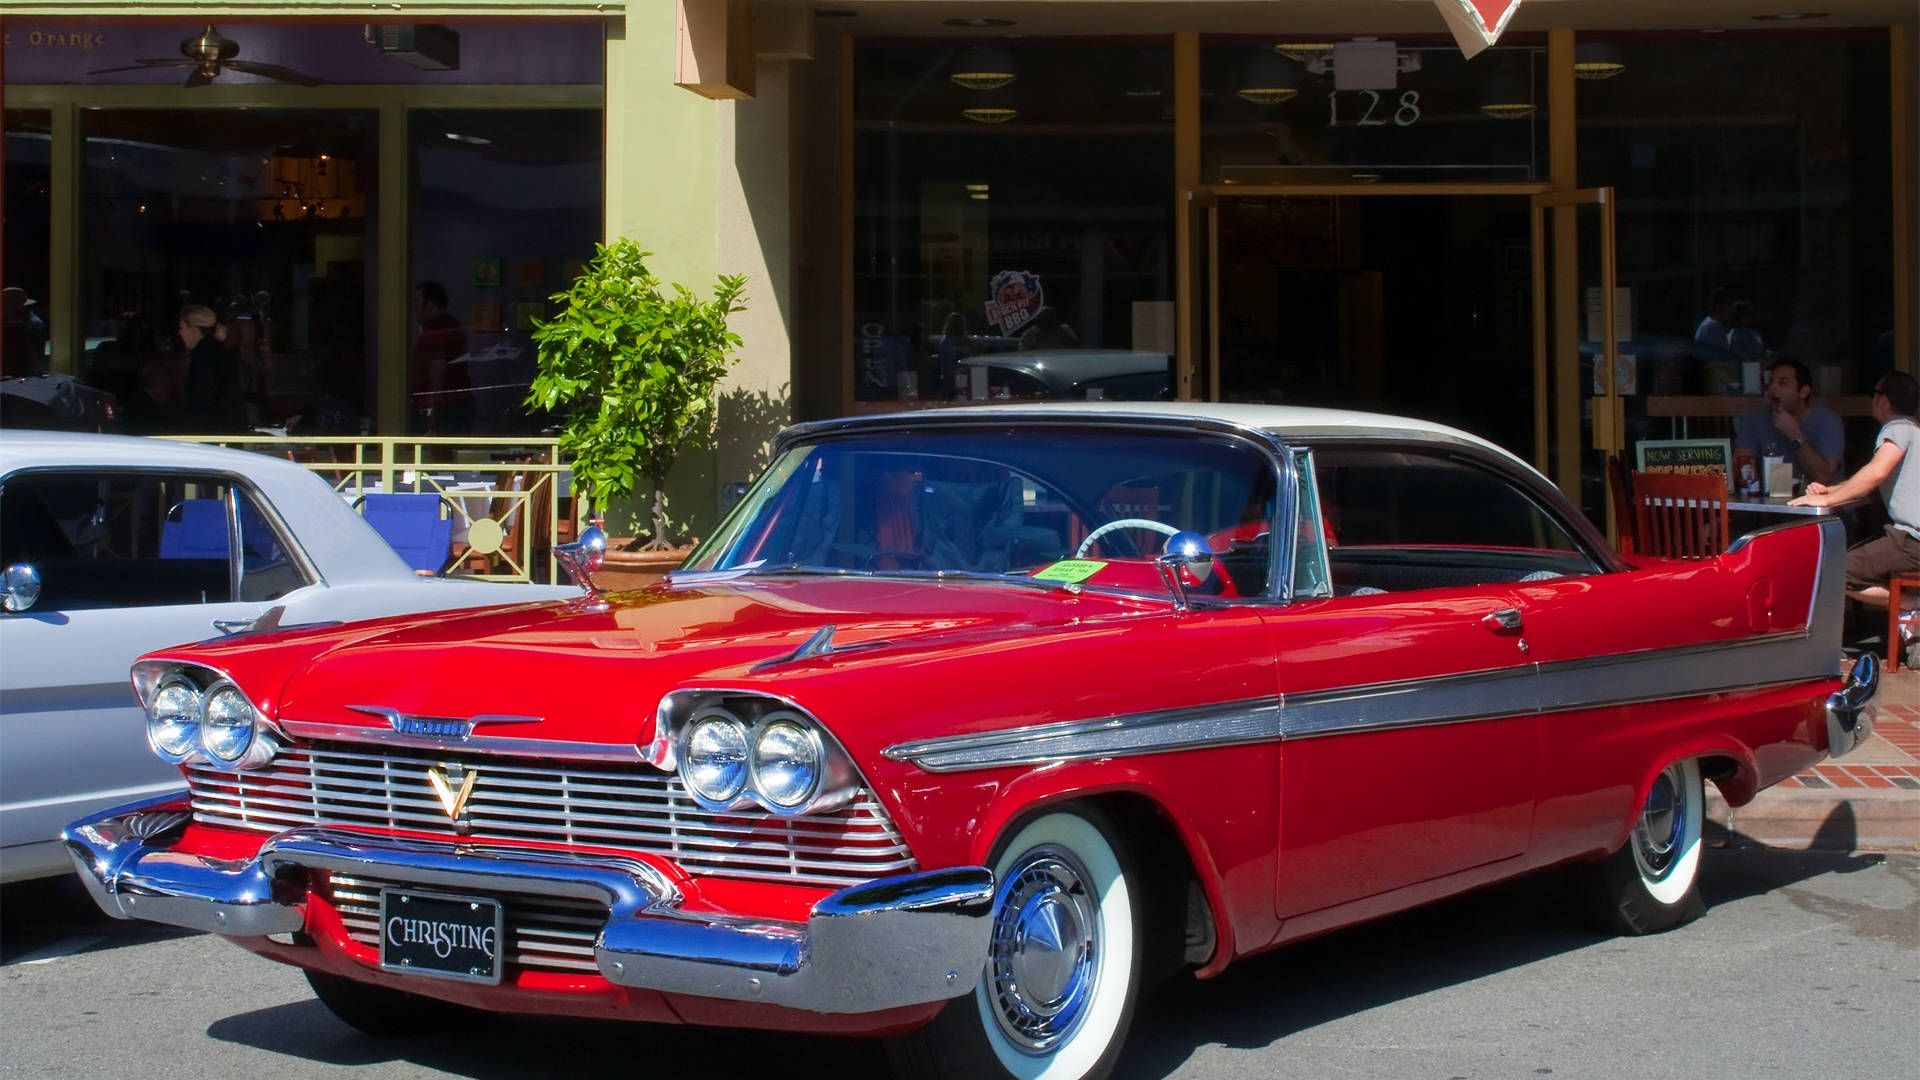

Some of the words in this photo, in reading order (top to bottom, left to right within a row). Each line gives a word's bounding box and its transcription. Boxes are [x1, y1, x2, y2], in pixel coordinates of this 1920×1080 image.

[29, 31, 105, 49] Orange
[1327, 89, 1422, 127] 128
[1004, 308, 1031, 329] BBQ
[1646, 450, 1671, 462] NOW
[1676, 447, 1722, 462] SERVING
[387, 916, 496, 958] CHRISTINE
